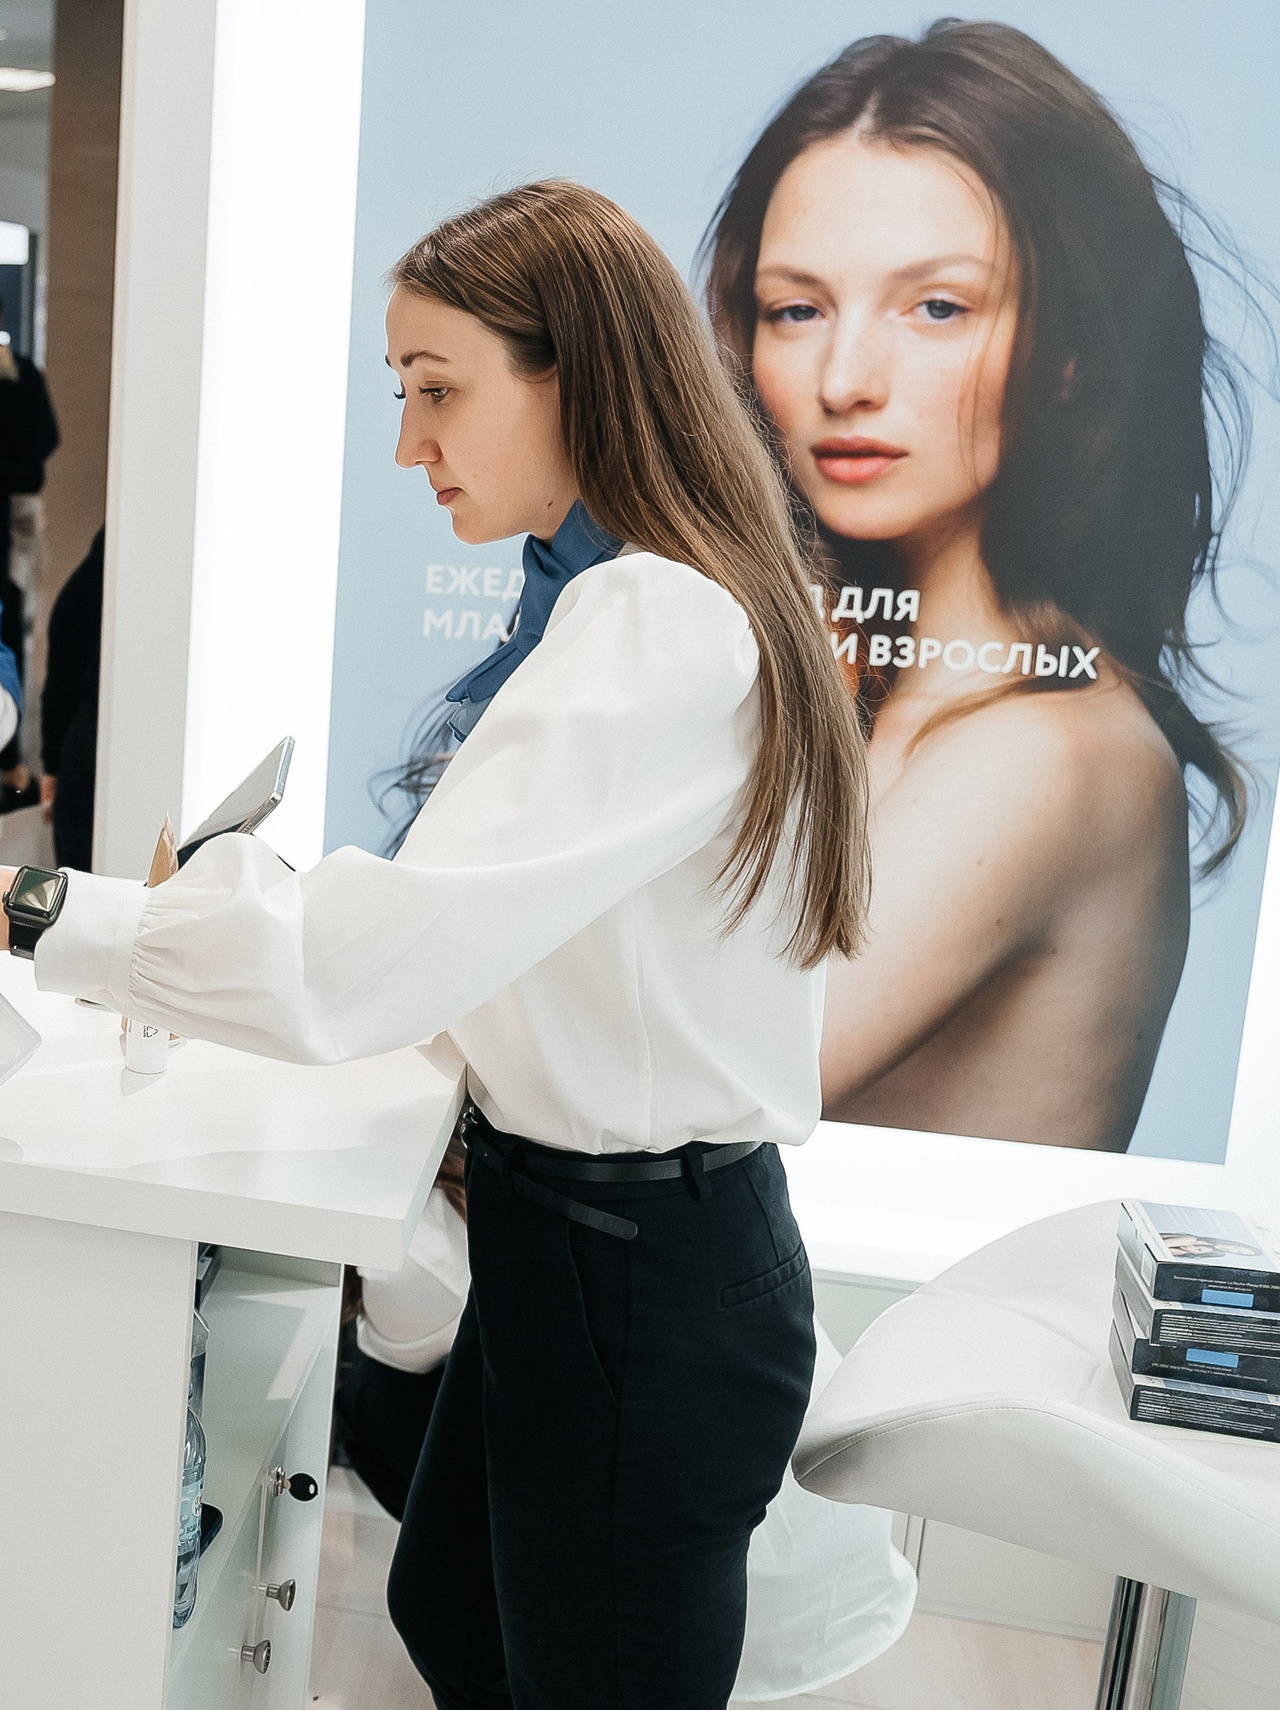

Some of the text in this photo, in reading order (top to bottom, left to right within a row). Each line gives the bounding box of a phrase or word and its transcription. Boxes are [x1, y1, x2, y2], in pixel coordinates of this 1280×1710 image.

[426, 564, 524, 601] ЕЖЕД
[831, 586, 920, 623] ДЛЯ
[423, 608, 510, 642] МЛА
[831, 631, 1101, 680] И ВЗРОСЛЫХ
